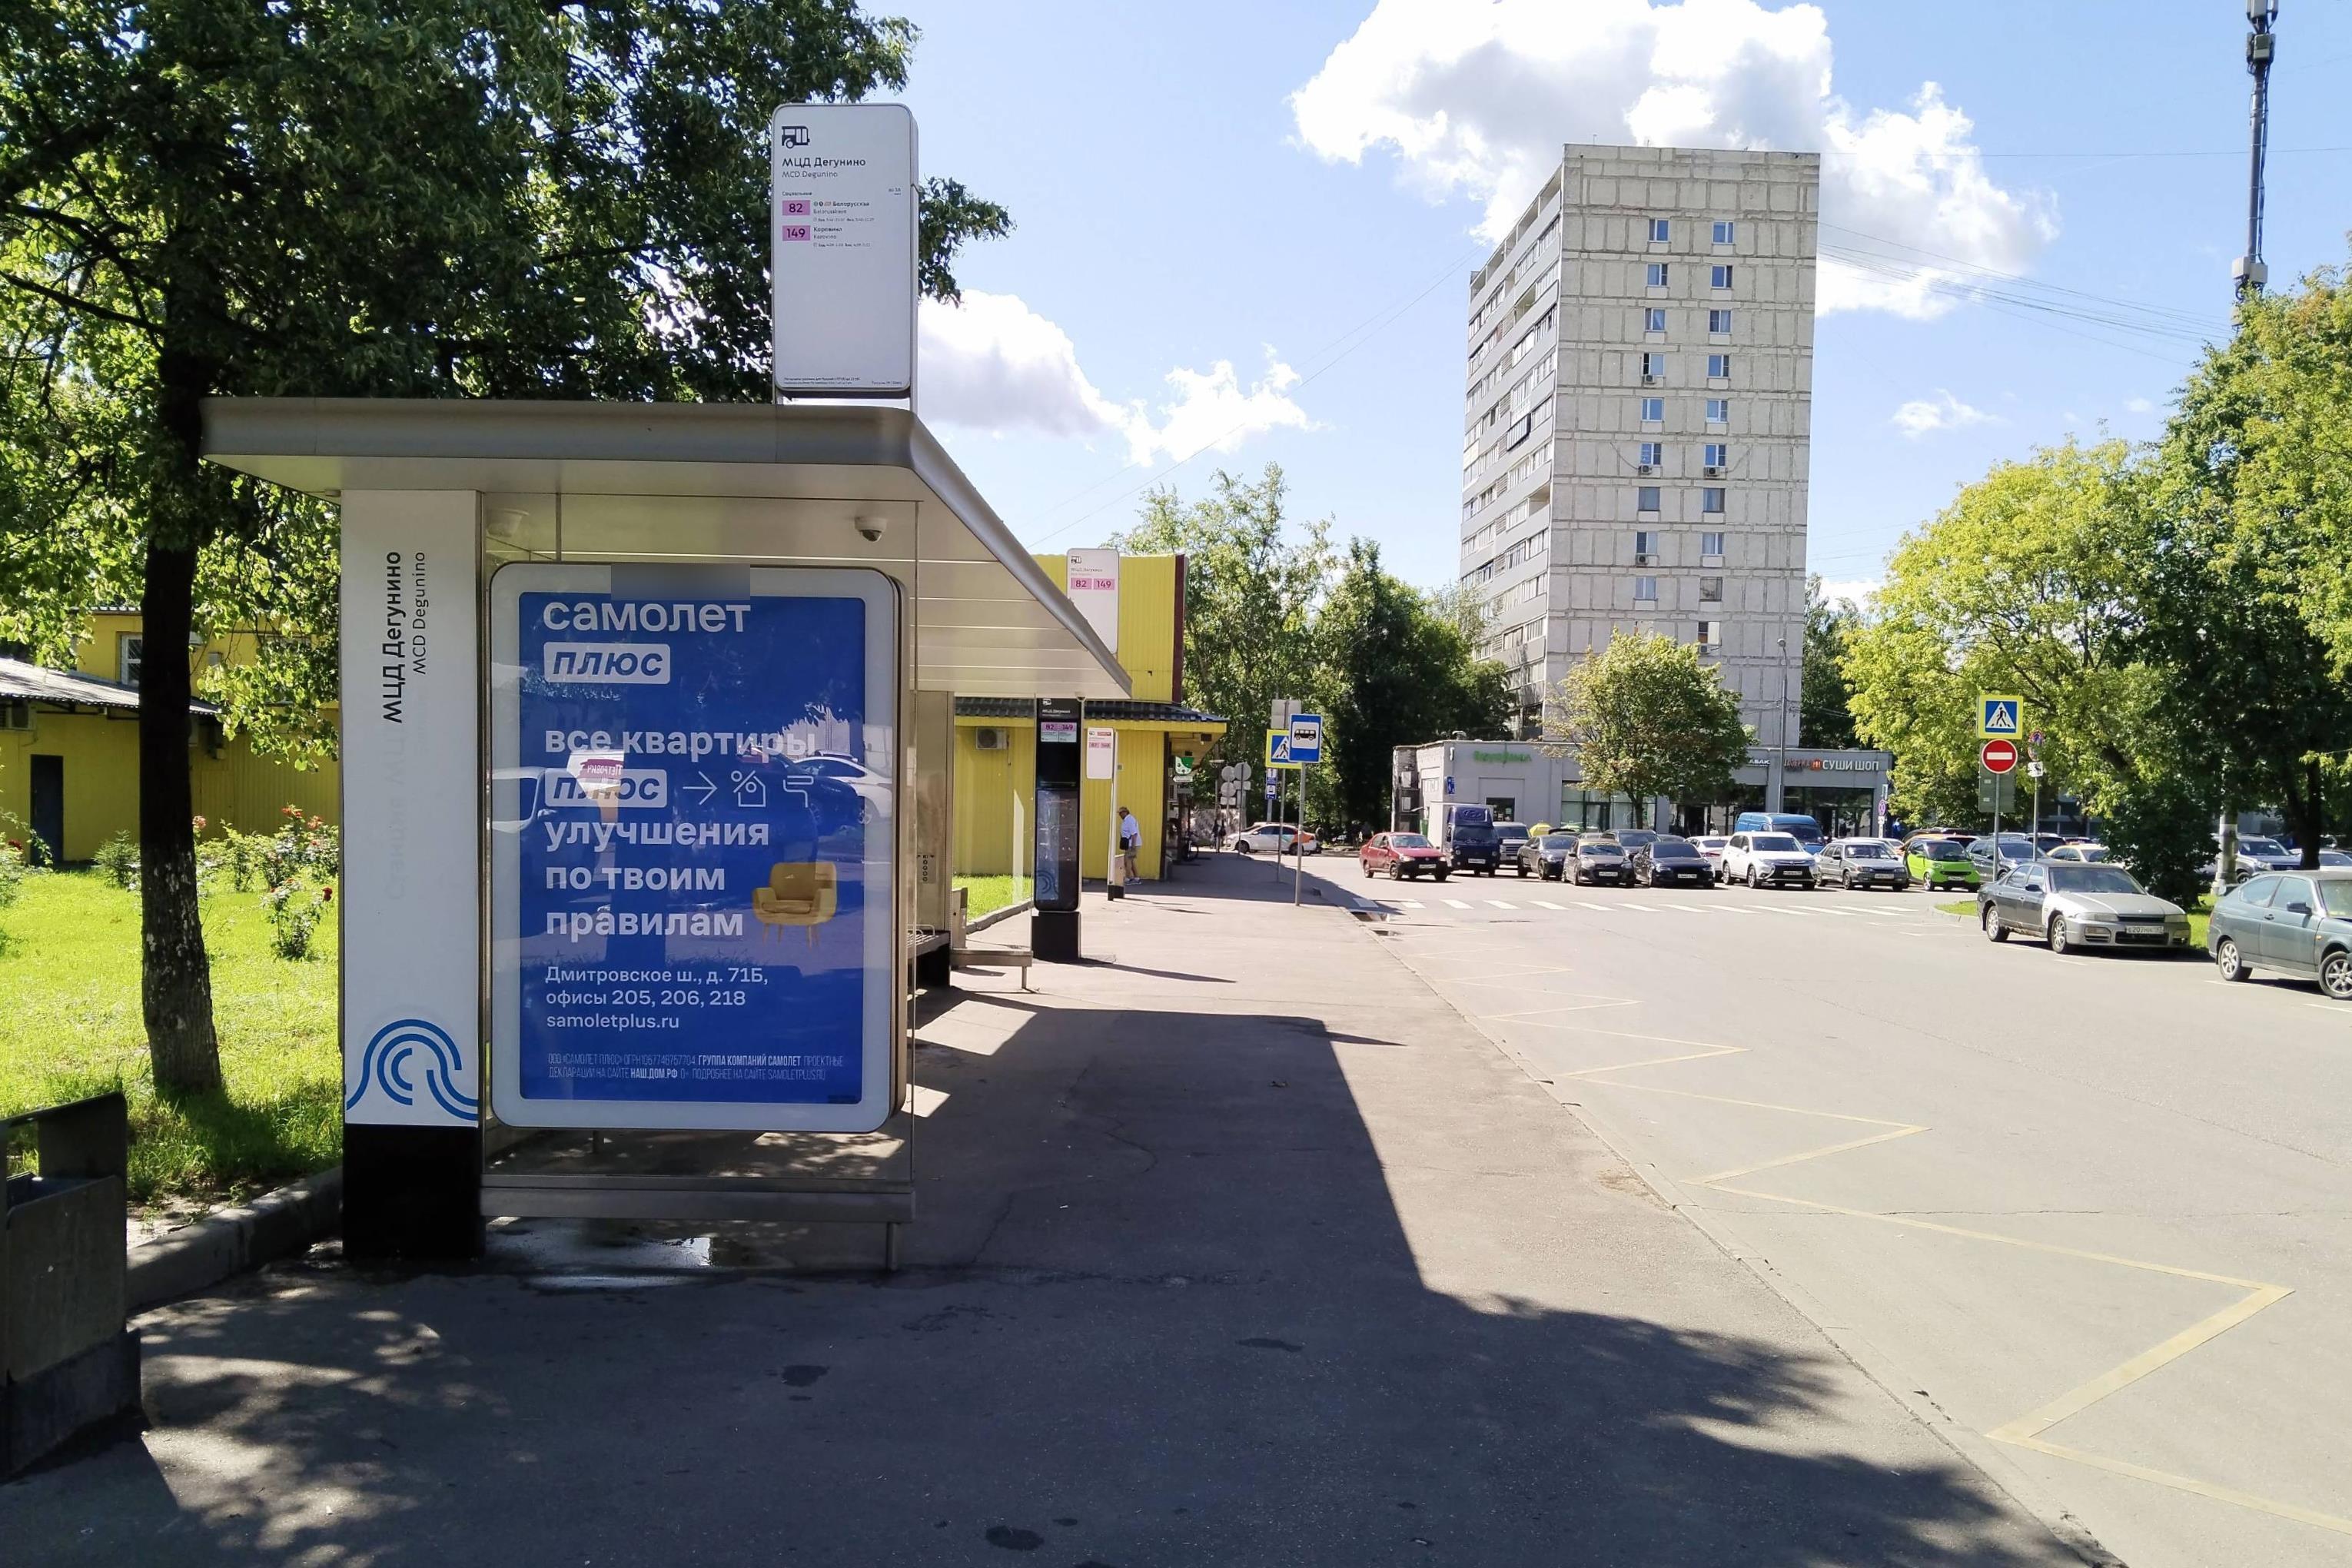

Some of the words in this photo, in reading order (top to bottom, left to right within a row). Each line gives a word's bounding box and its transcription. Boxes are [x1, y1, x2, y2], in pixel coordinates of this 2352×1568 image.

[782, 158, 811, 168] МЦД
[814, 158, 866, 168] Дегунино
[789, 203, 803, 213] 82
[786, 228, 806, 238] 149
[412, 552, 429, 630] Degunino
[1075, 580, 1087, 588] 82
[1097, 580, 1111, 588] 149
[382, 551, 407, 659] Дегунино
[543, 601, 751, 633] самолет
[412, 633, 426, 675] MCD
[553, 652, 663, 676] плюс
[382, 664, 406, 724] МЦД
[546, 730, 613, 753] все
[623, 731, 815, 762] квартиры
[1822, 759, 1853, 771] СУШИ
[1855, 759, 1879, 771] ШОП
[545, 821, 769, 852] улучшения
[546, 867, 592, 890] по
[602, 867, 726, 891] твоим
[546, 912, 743, 942] правилам
[545, 966, 672, 984] Дмитровское
[677, 970, 702, 985] ш.,
[706, 970, 724, 985] д.
[728, 968, 769, 985] 71Б,
[546, 991, 607, 1008] офисы
[612, 991, 656, 1007] 205,
[660, 991, 706, 1007] 206,
[709, 991, 746, 1005] 218
[546, 1013, 679, 1032] samoletplus.ru
[698, 1055, 726, 1066] ГРУППА
[727, 1053, 766, 1066] КОМПАНИЙ
[768, 1055, 801, 1067] САМОЛЕТ
[630, 1068, 678, 1080] НАШ.ДОМ.РФ
